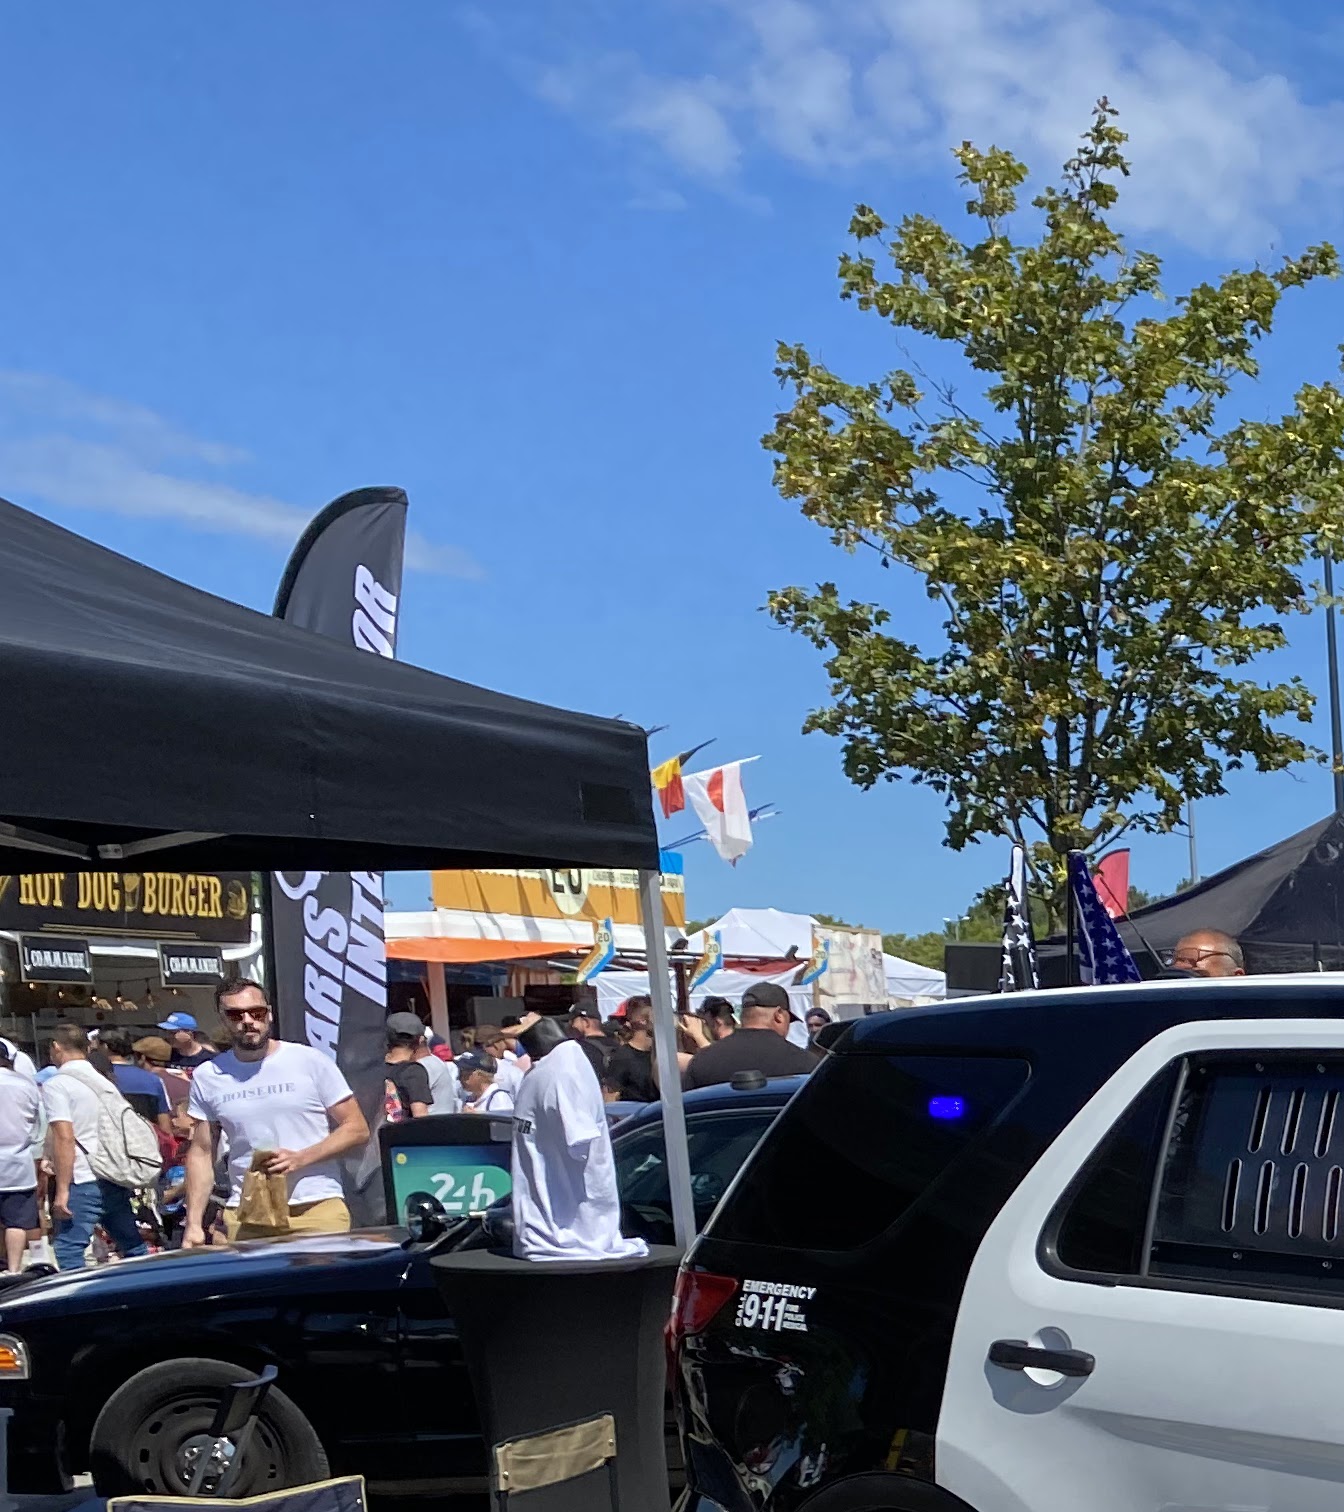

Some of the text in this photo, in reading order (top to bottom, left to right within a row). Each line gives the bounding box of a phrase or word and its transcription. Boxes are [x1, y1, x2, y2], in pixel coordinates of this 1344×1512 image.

[18, 872, 223, 918] HOT DOG BURGER
[742, 1279, 817, 1299] EMERGENCY
